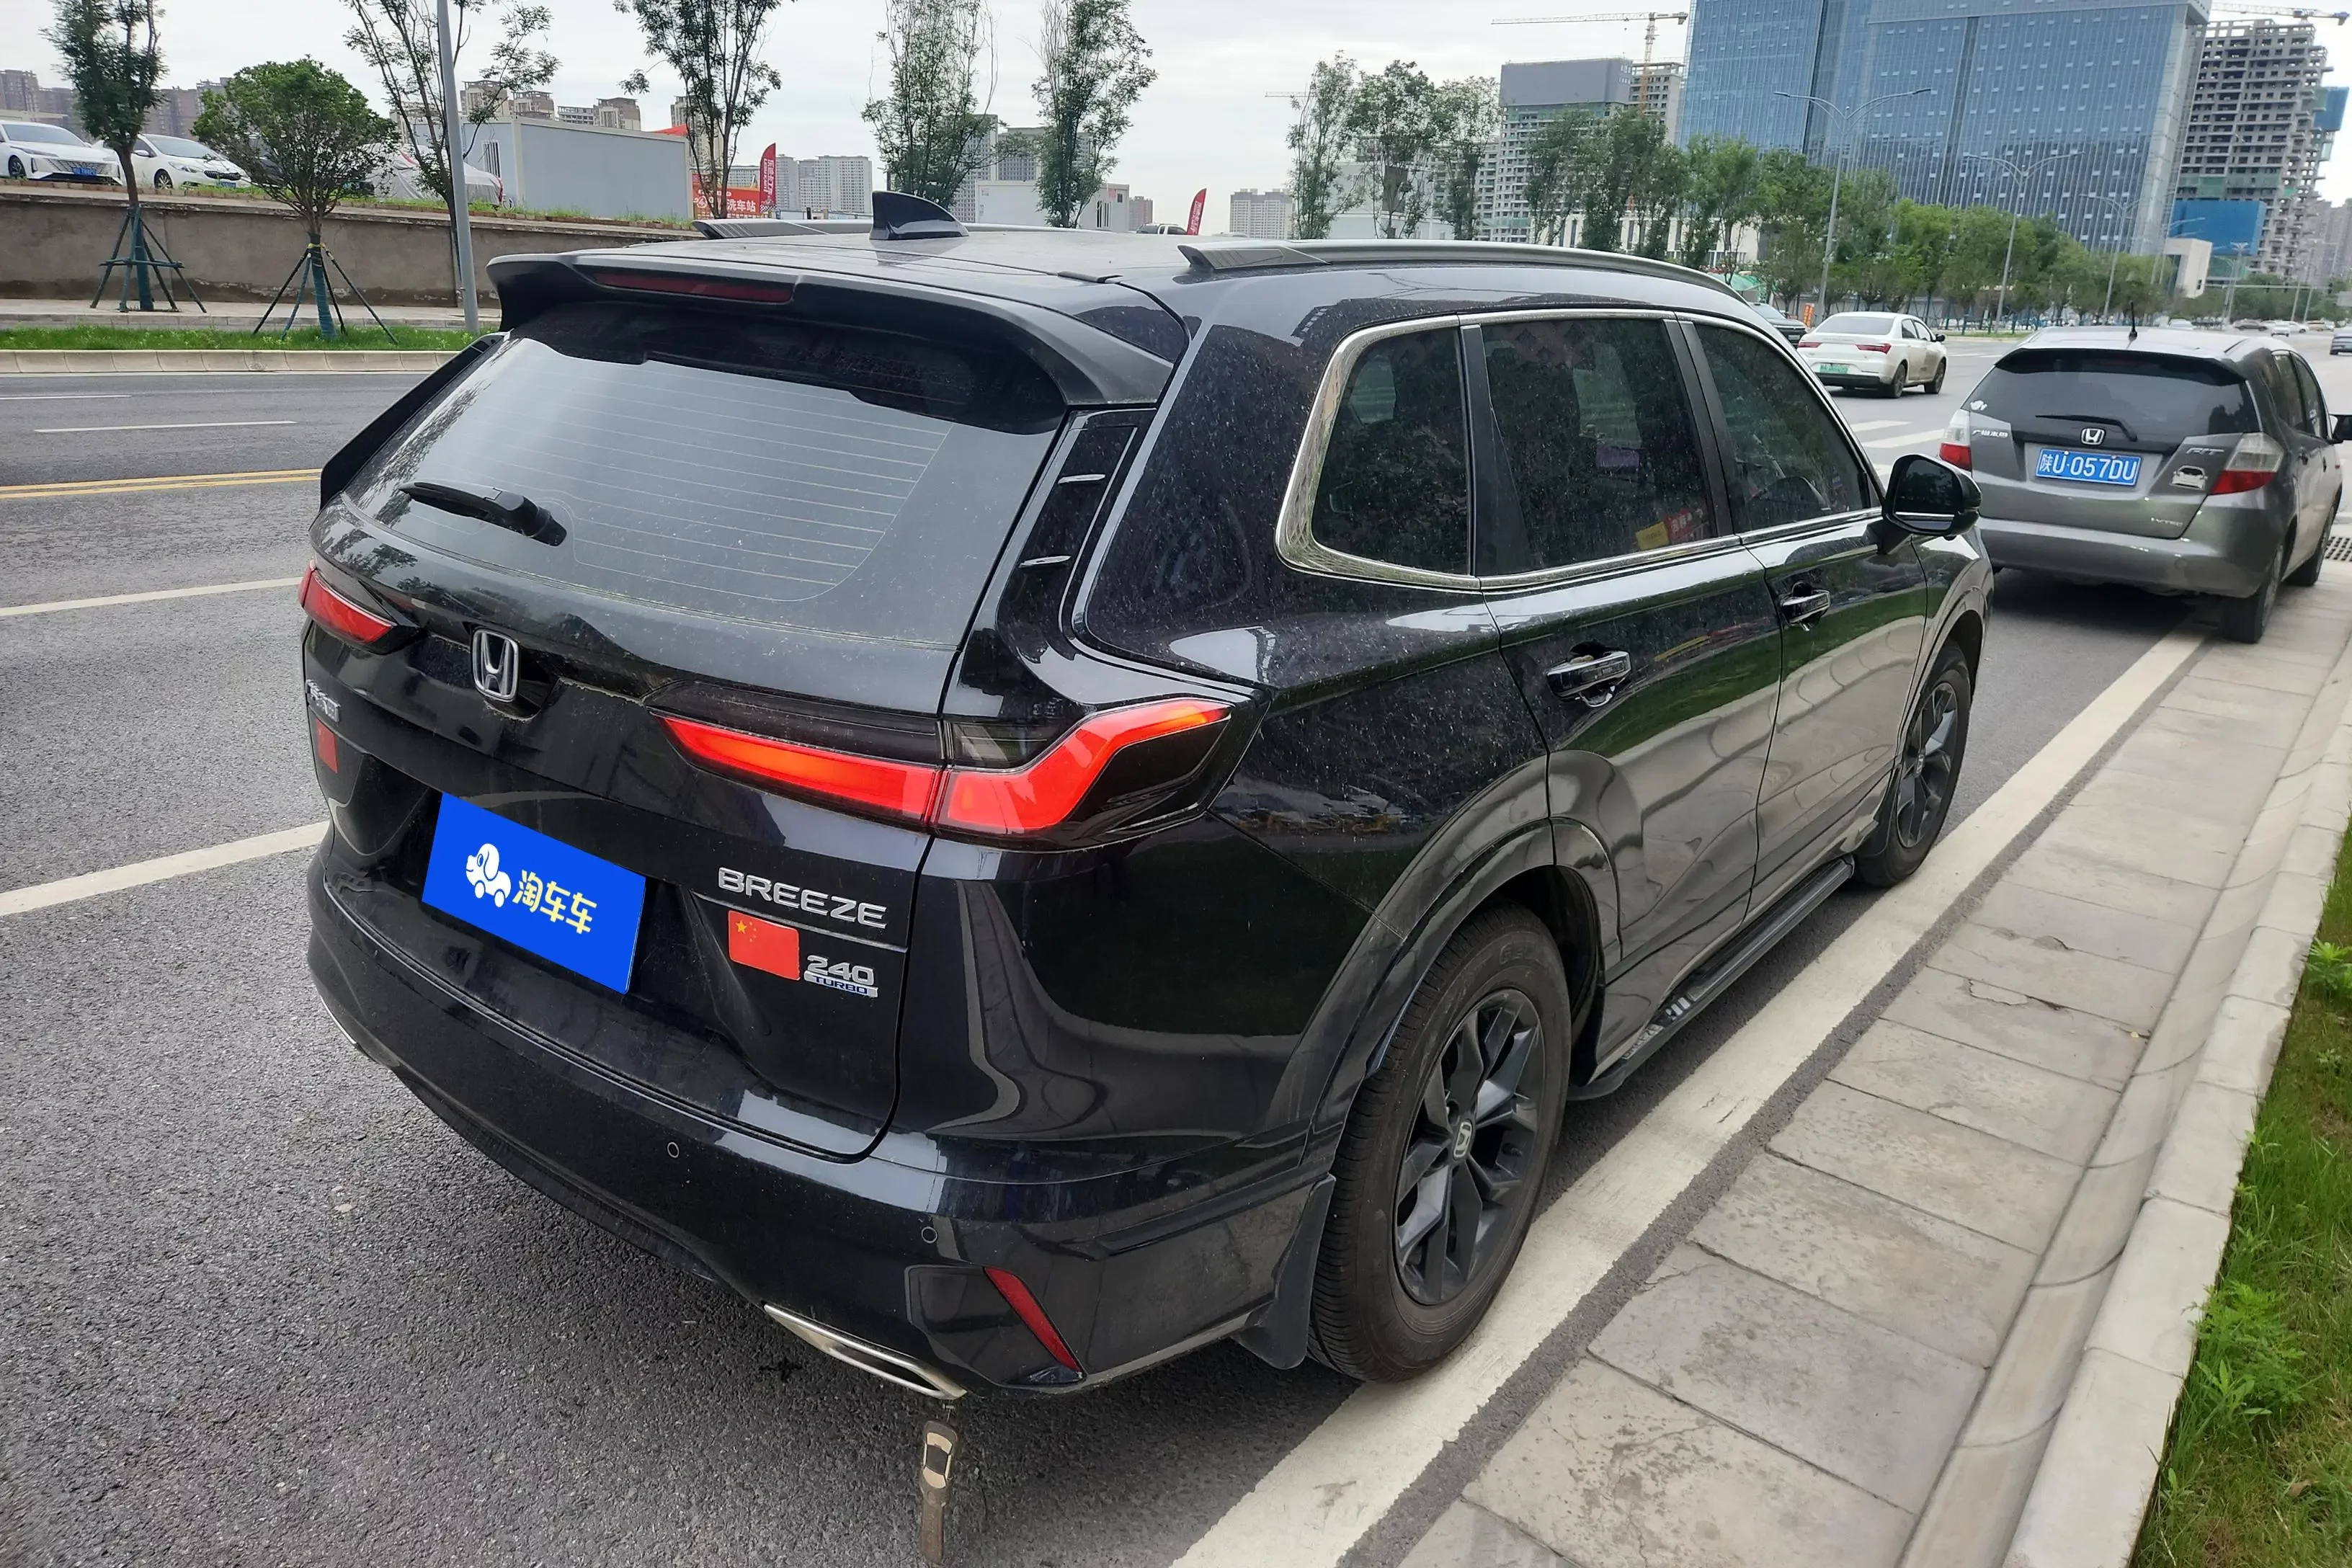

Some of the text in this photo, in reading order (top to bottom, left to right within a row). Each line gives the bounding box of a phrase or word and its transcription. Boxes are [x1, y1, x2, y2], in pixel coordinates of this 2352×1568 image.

[718, 867, 887, 929] BREEZE
[806, 955, 875, 986] 240
[813, 975, 868, 994] TURBO
